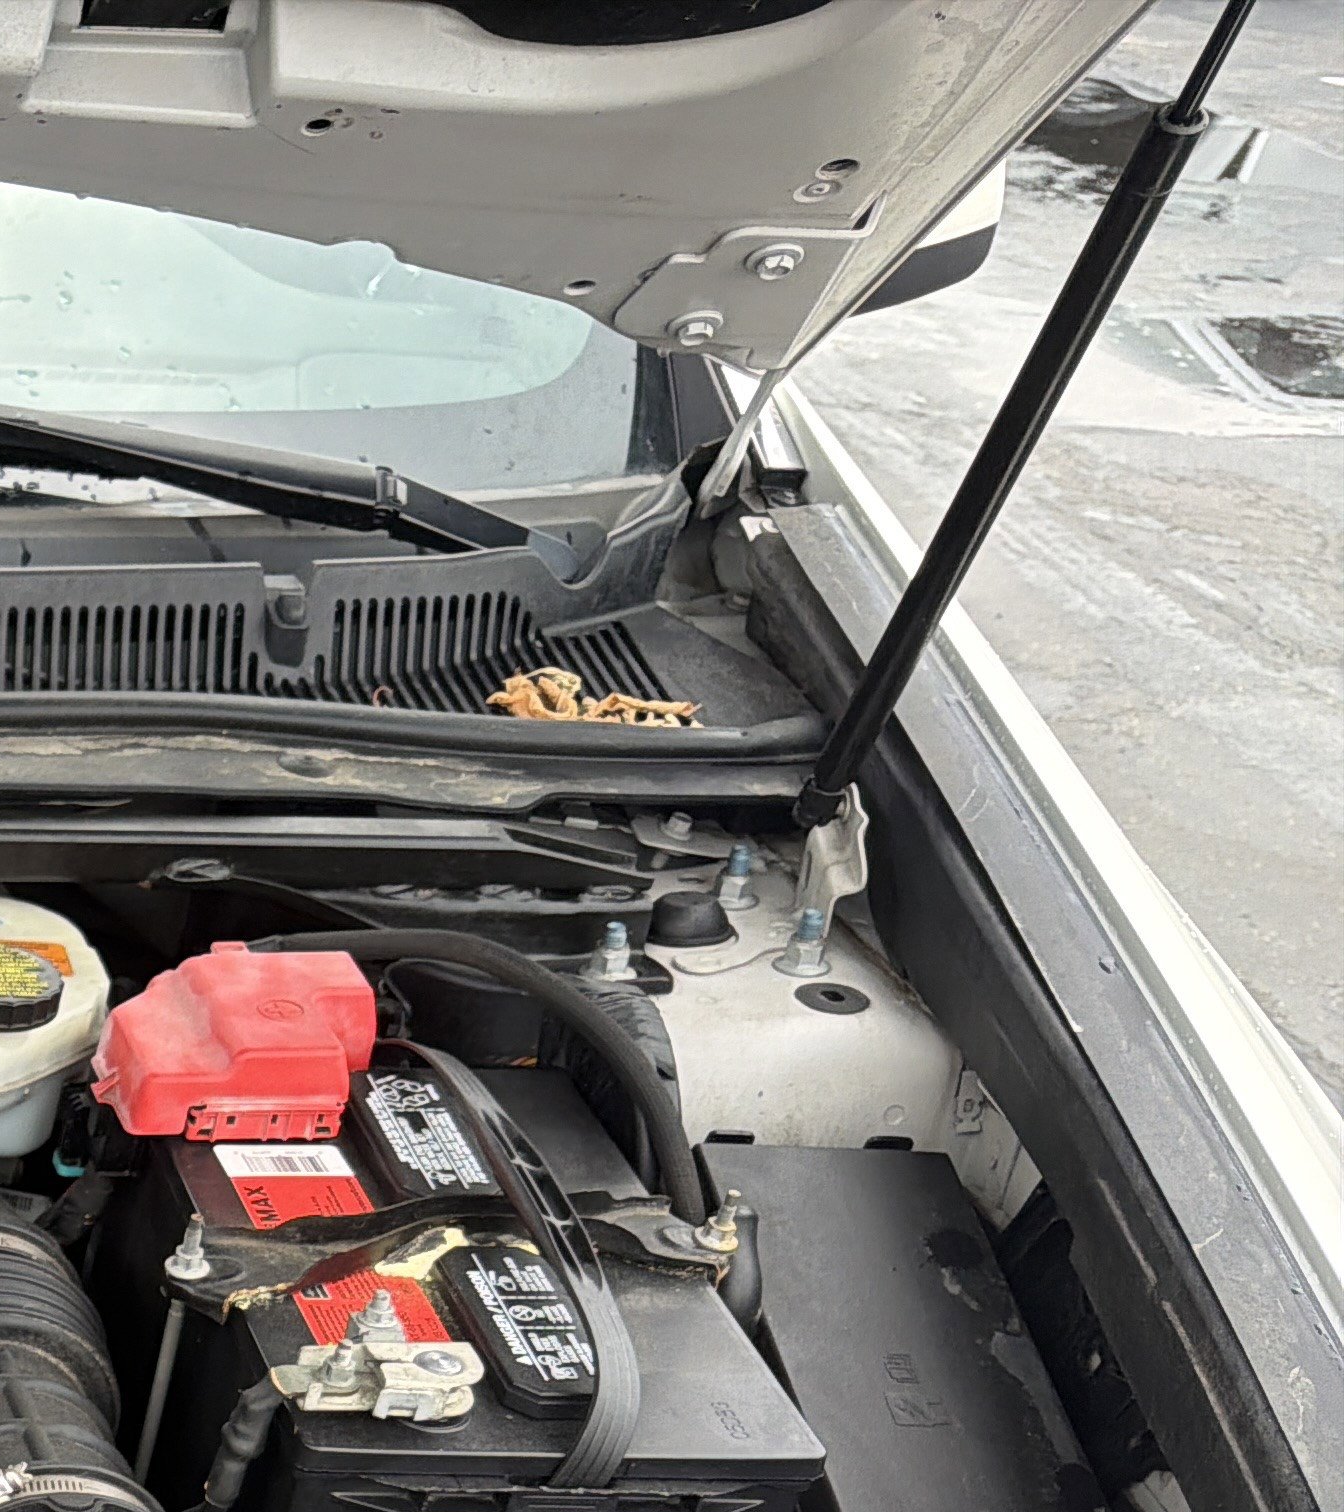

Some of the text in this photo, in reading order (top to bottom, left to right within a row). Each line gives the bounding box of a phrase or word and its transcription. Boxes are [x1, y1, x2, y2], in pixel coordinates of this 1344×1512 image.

[243, 1186, 281, 1222] MAX
[466, 1270, 499, 1306] POISON
[492, 1314, 527, 1355] DANGER
